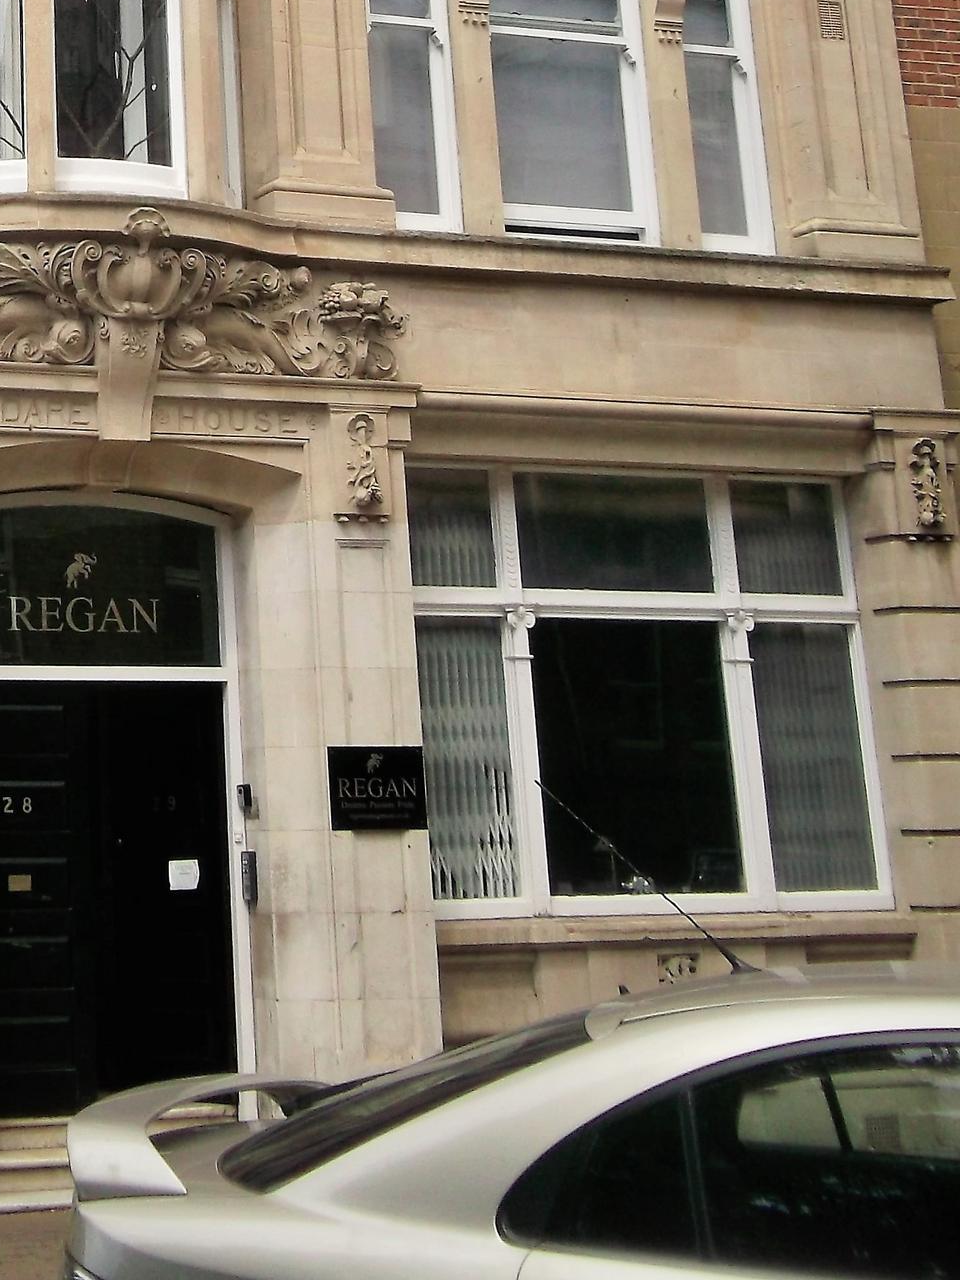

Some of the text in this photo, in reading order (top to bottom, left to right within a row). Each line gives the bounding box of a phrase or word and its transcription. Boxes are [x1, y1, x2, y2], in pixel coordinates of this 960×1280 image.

[178, 404, 299, 434] HOUSE
[6, 595, 160, 634] REGAN
[337, 777, 418, 798] REGAN
[2, 796, 33, 814] 28
